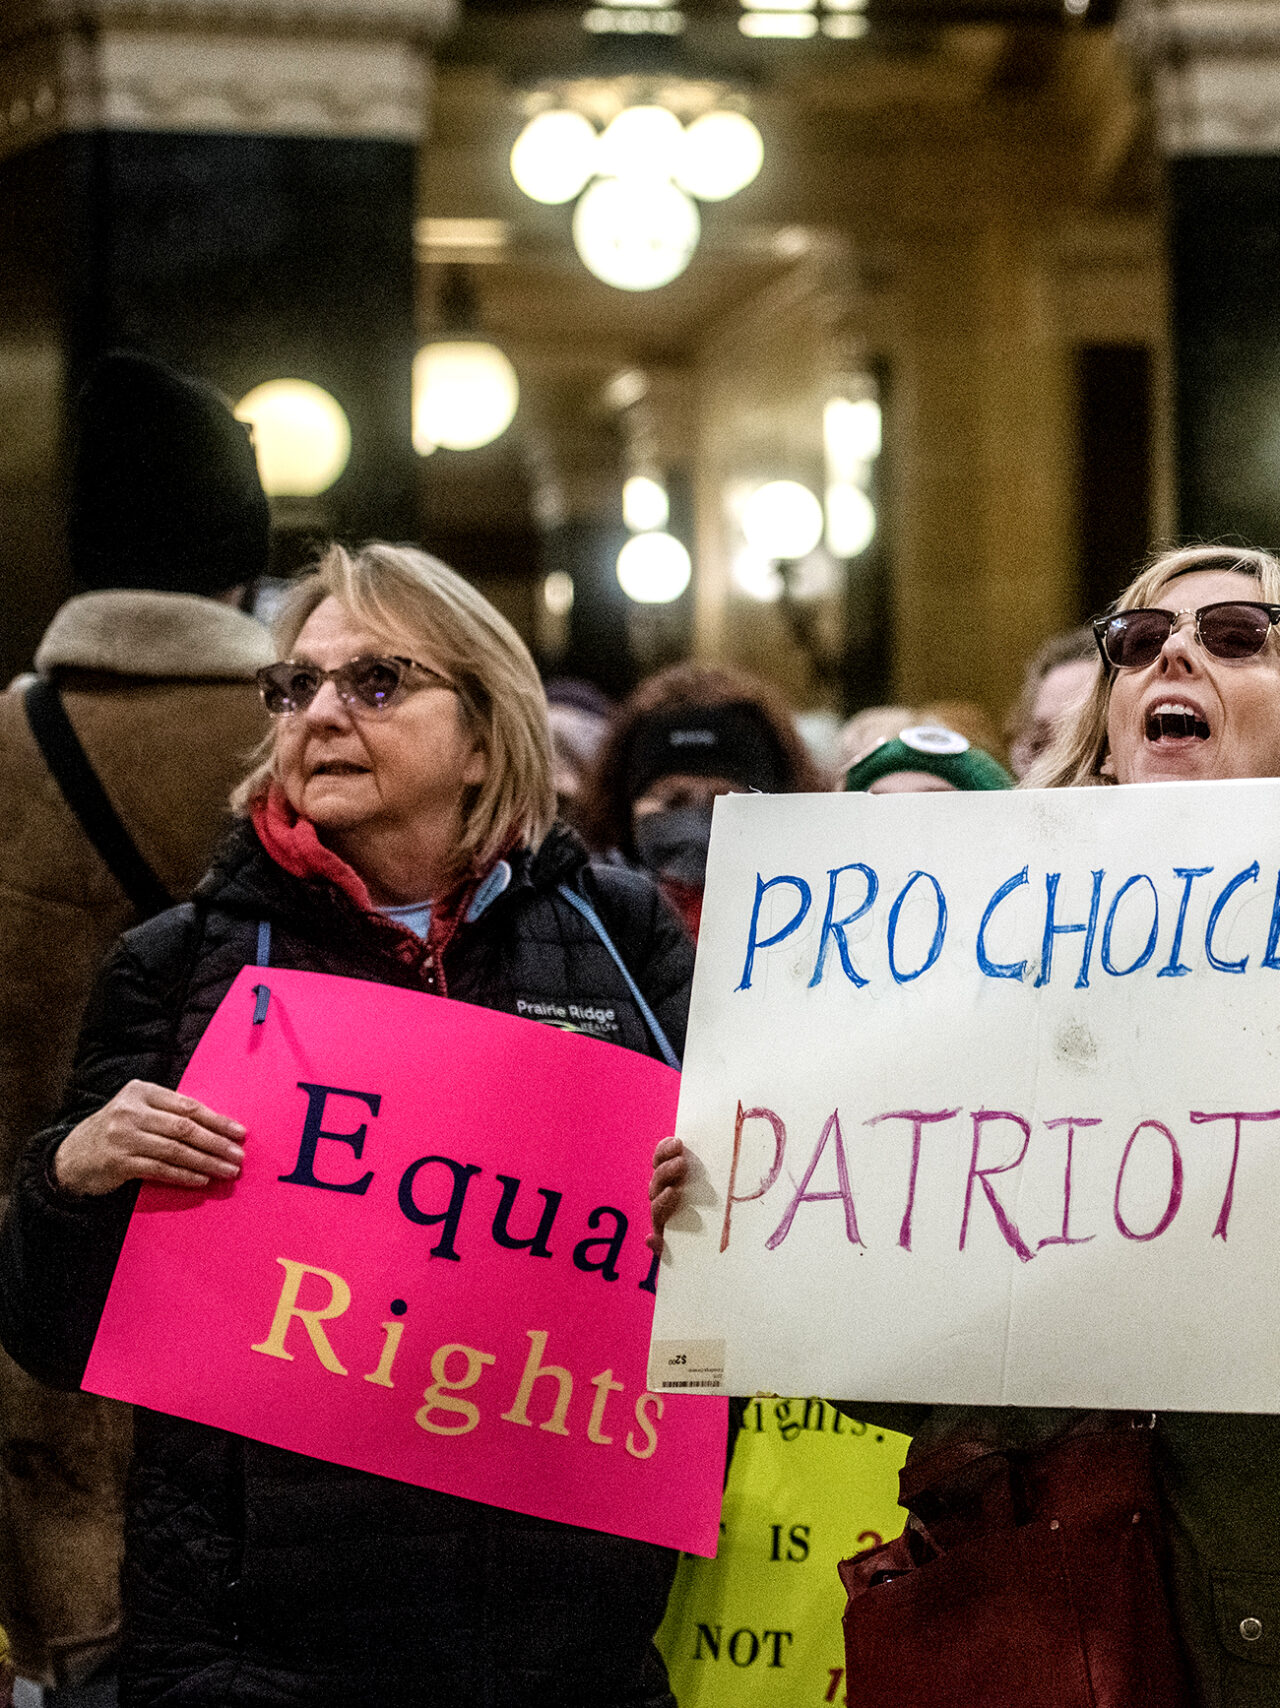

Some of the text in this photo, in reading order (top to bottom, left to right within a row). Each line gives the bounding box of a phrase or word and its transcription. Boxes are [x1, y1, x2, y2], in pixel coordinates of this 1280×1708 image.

[734, 862, 948, 992] PRO
[516, 1000, 616, 1025] Prairie Ridge
[251, 1257, 664, 1460] Rights
[769, 1524, 811, 1562] IS
[693, 1624, 793, 1668] NOT
